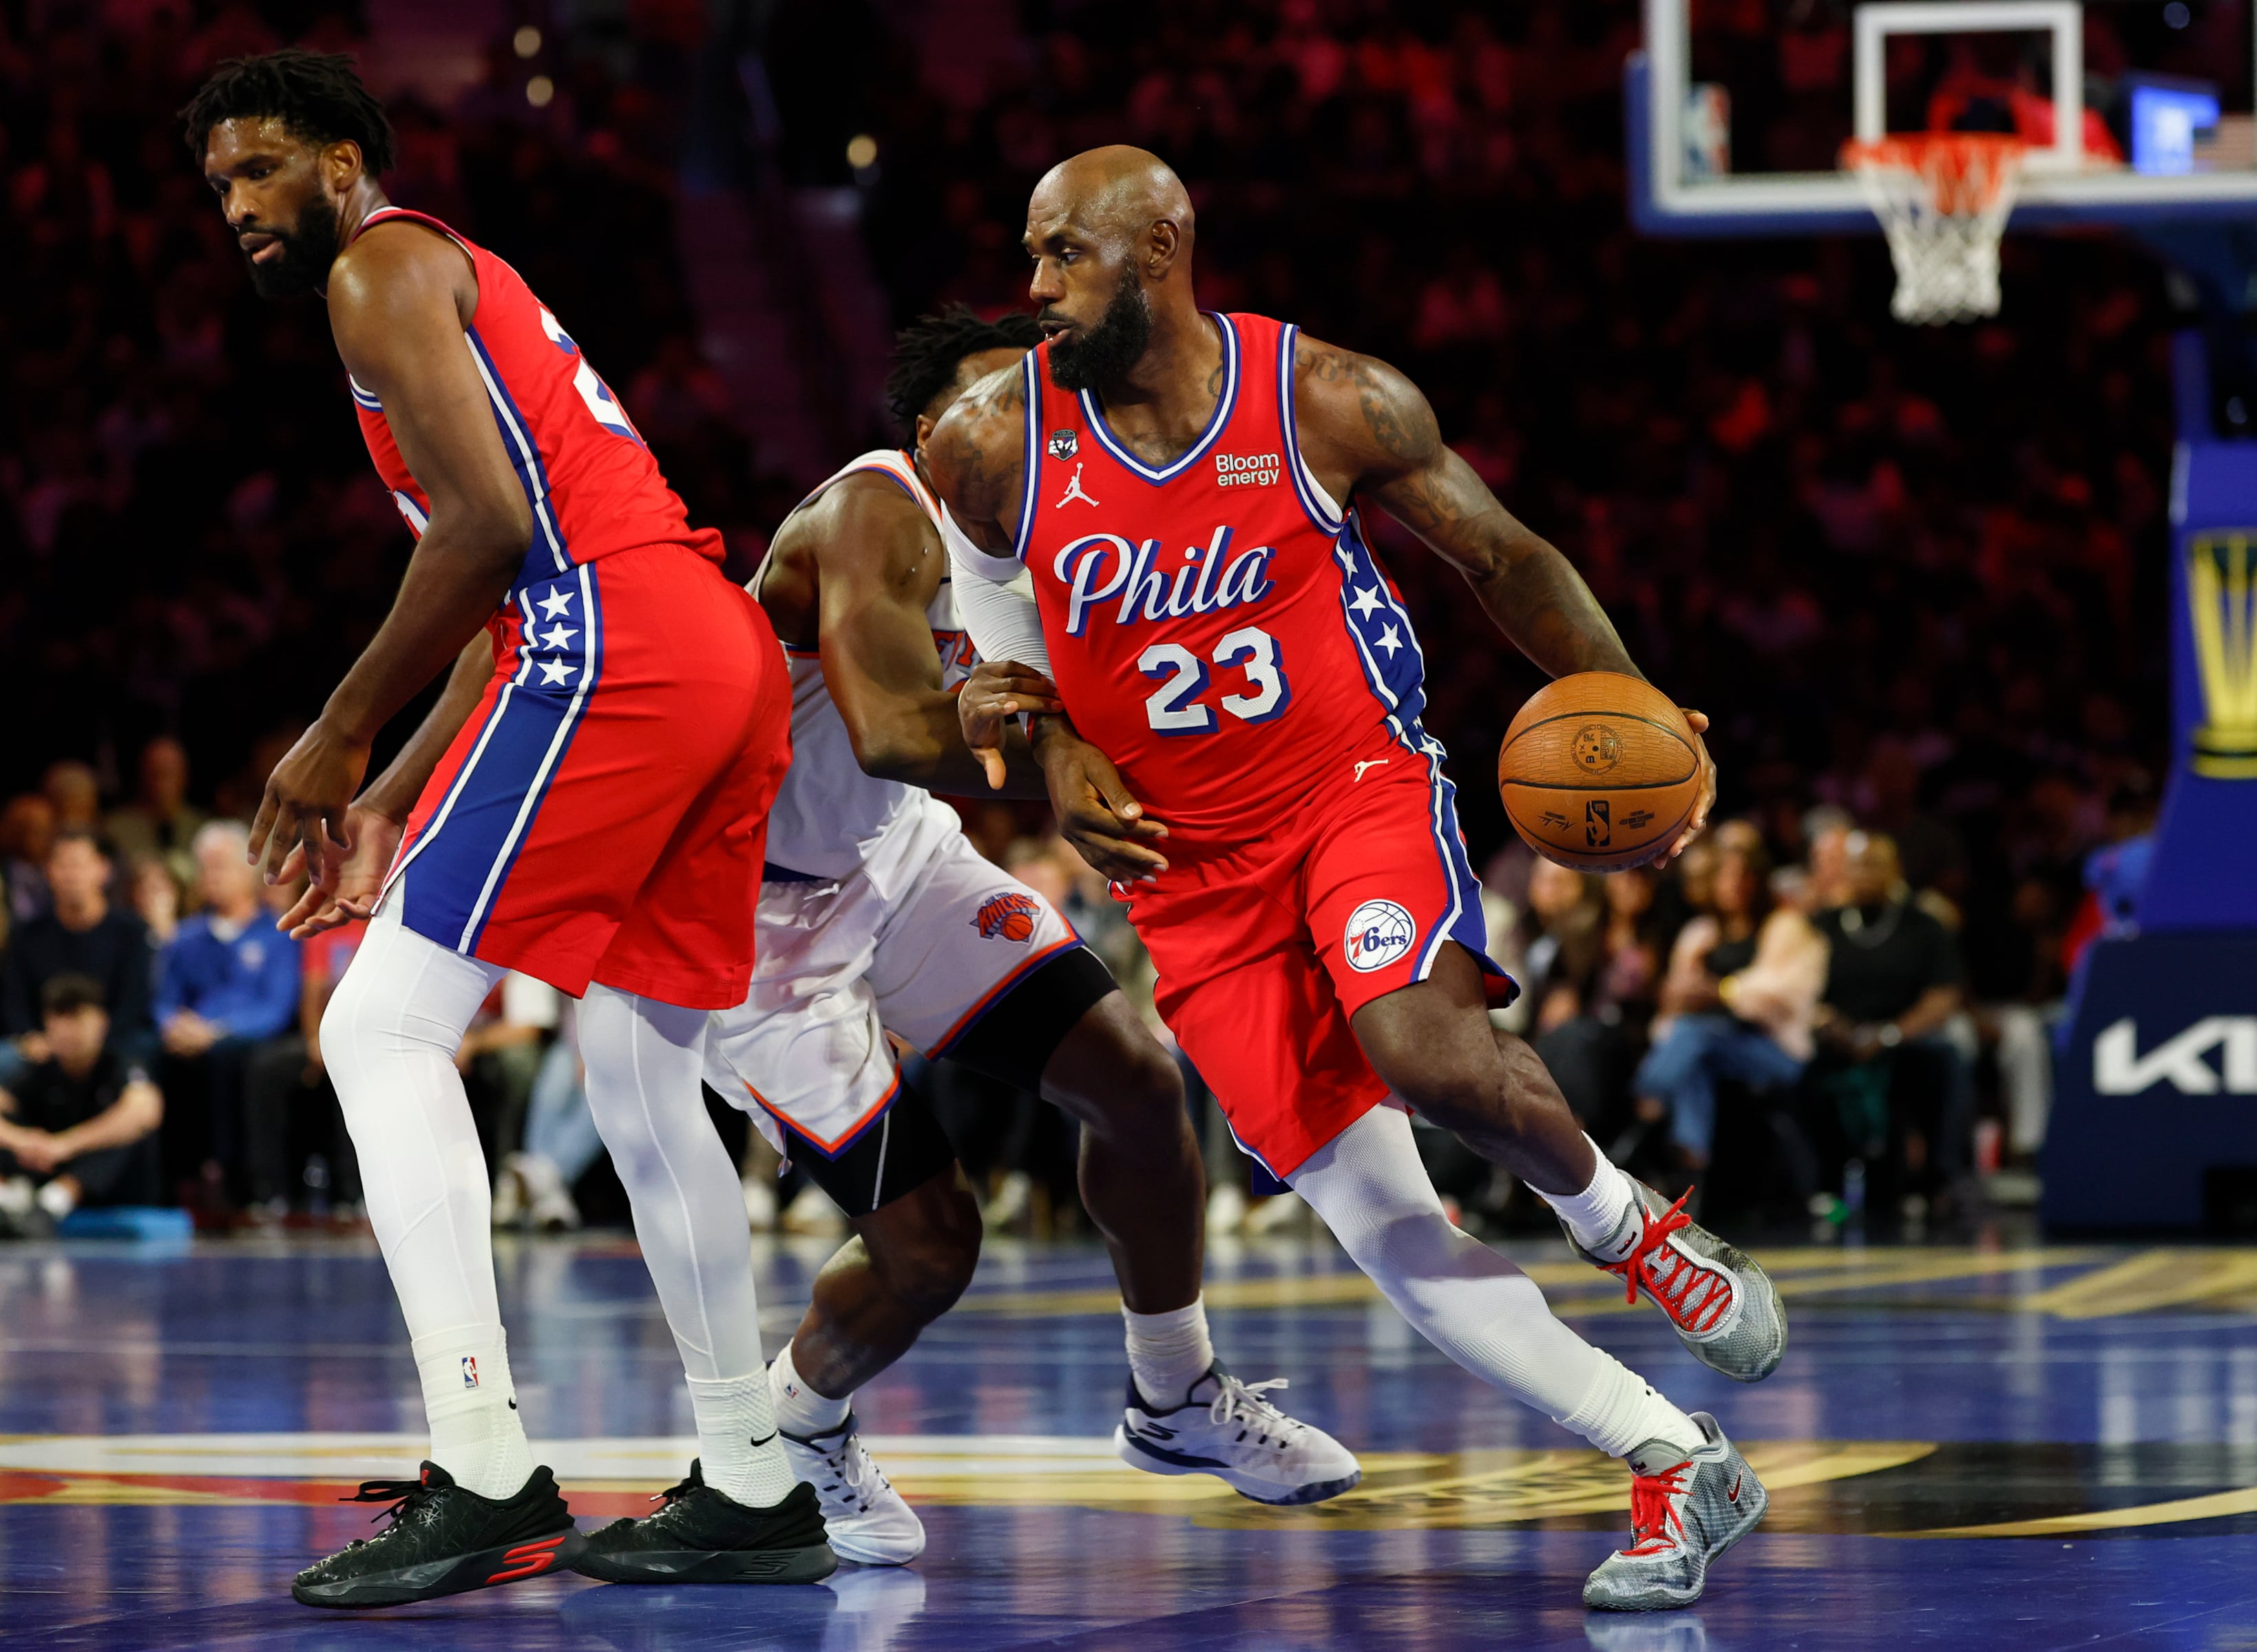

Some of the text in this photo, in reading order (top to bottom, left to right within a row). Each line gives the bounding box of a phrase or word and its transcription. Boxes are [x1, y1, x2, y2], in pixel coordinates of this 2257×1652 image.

[539, 306, 646, 452] 2
[1216, 454, 1279, 473] Bloom
[1217, 469, 1279, 487] energy
[1053, 525, 1276, 637] Phila
[1137, 626, 1292, 737] 23
[1594, 803, 1607, 812] NBA
[978, 893, 1040, 938] KNICKS
[1350, 926, 1407, 960] 76ers
[2093, 1015, 2257, 1094] KI
